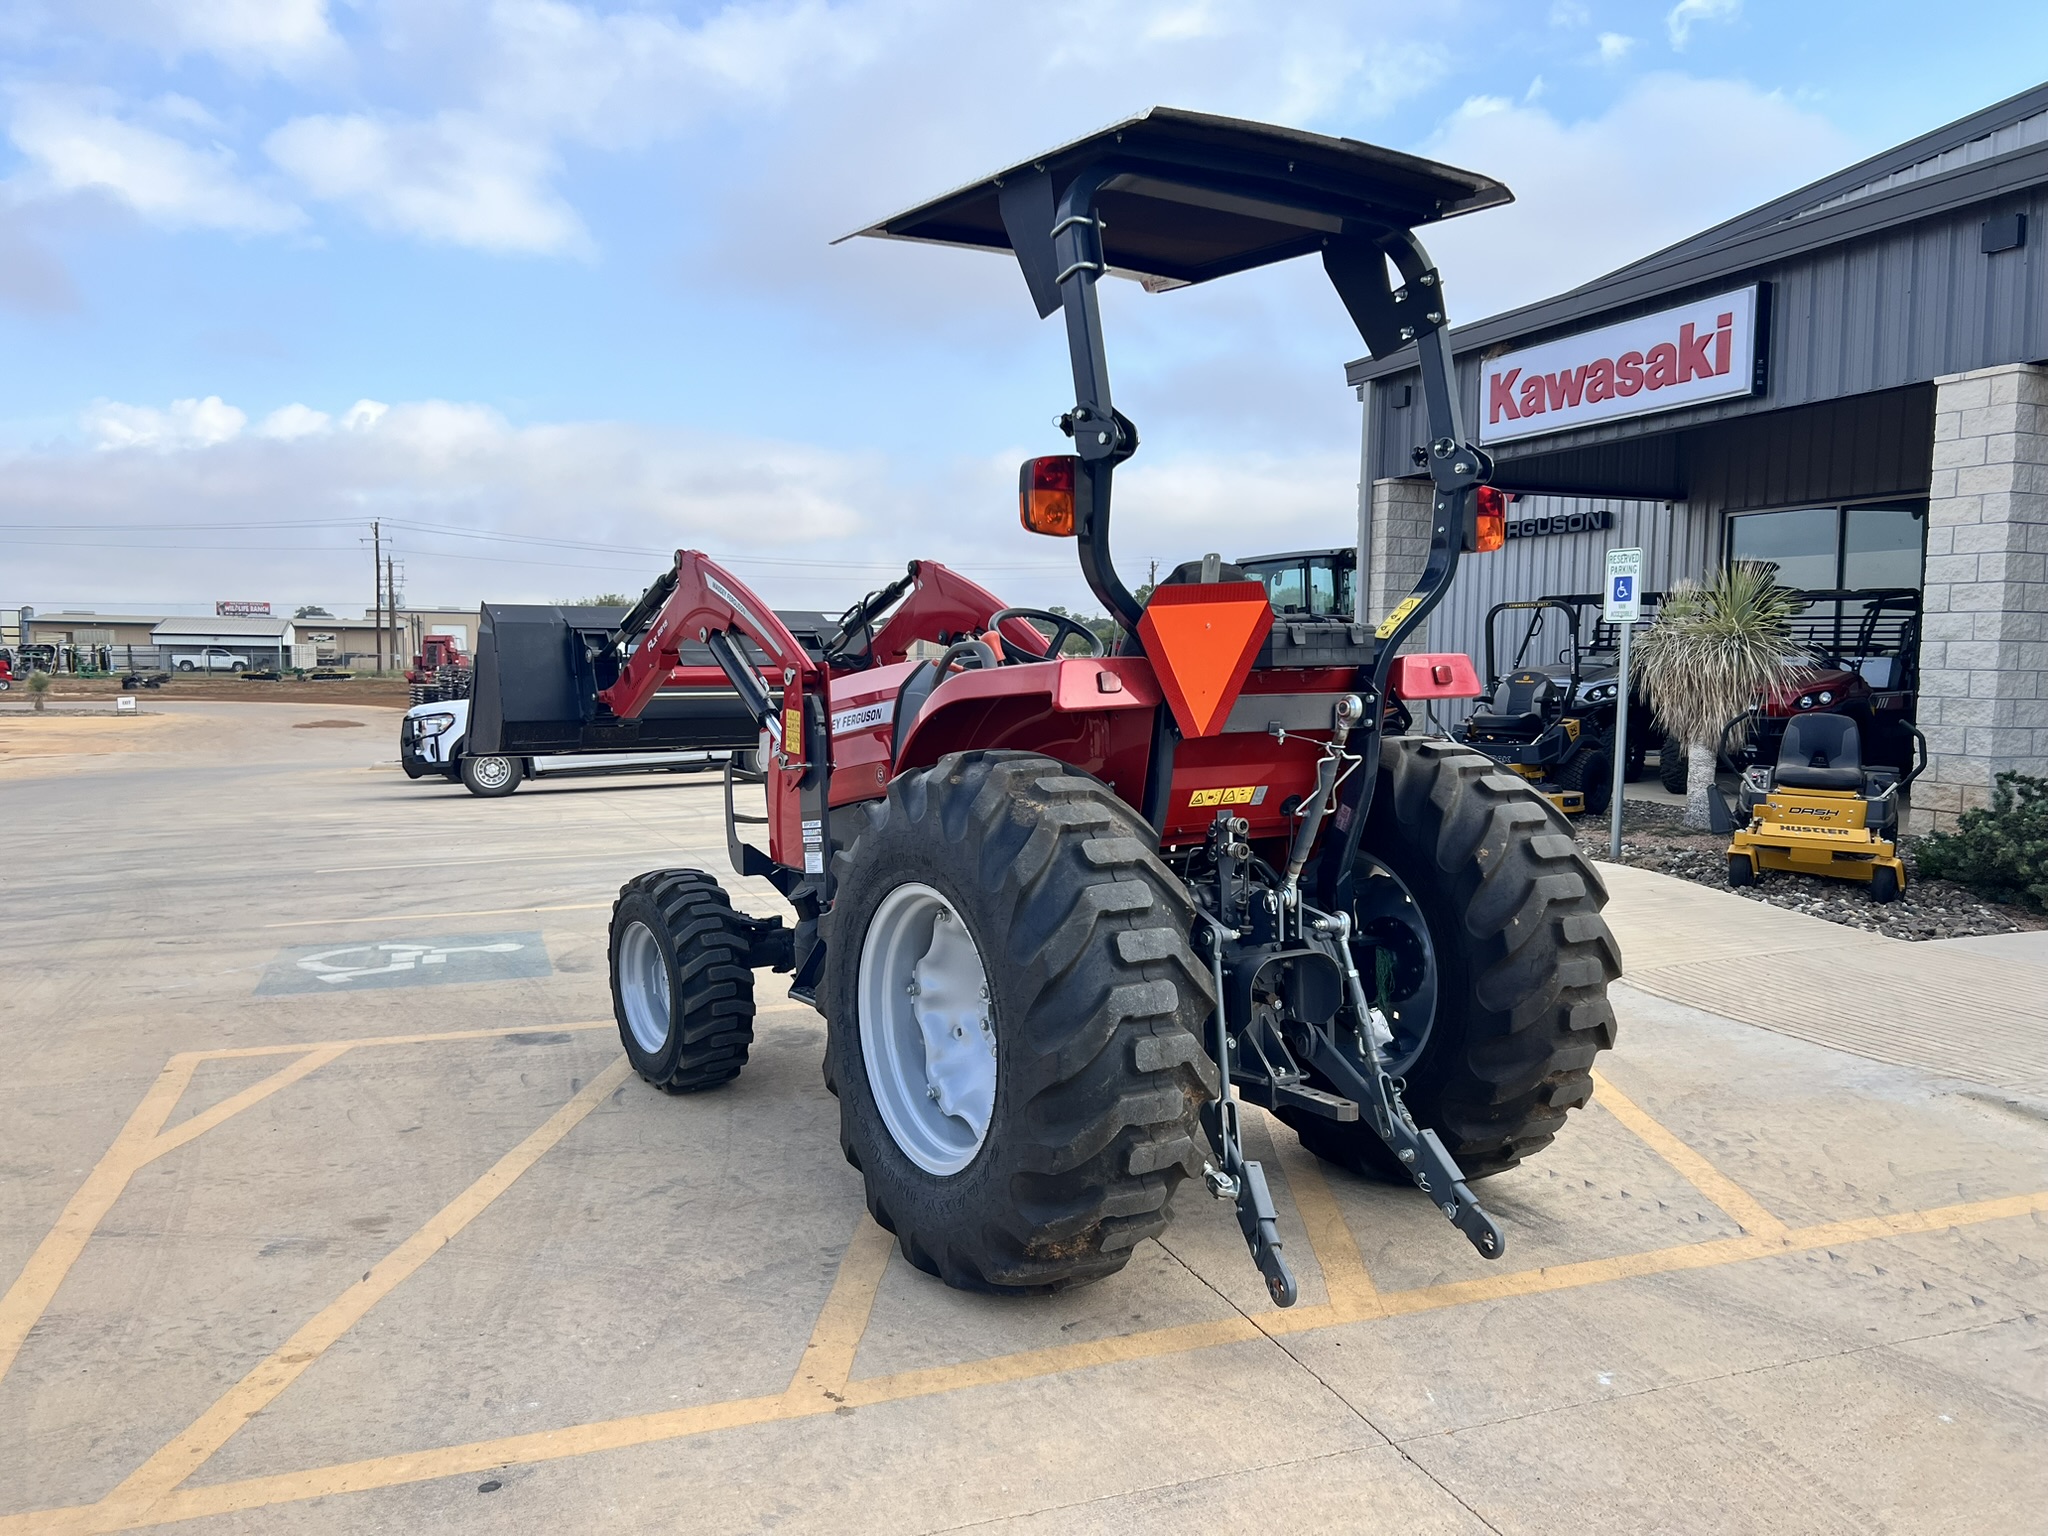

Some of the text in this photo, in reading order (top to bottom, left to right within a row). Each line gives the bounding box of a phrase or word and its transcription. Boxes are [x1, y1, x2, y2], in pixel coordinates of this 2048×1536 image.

[1488, 311, 1733, 425] Kawasaki
[1609, 553, 1639, 564] RESERVED
[1610, 564, 1638, 575] PARKING
[842, 708, 882, 727] FERGUSON
[1789, 807, 1839, 817] DASH
[1780, 825, 1849, 835] HUSTLER
